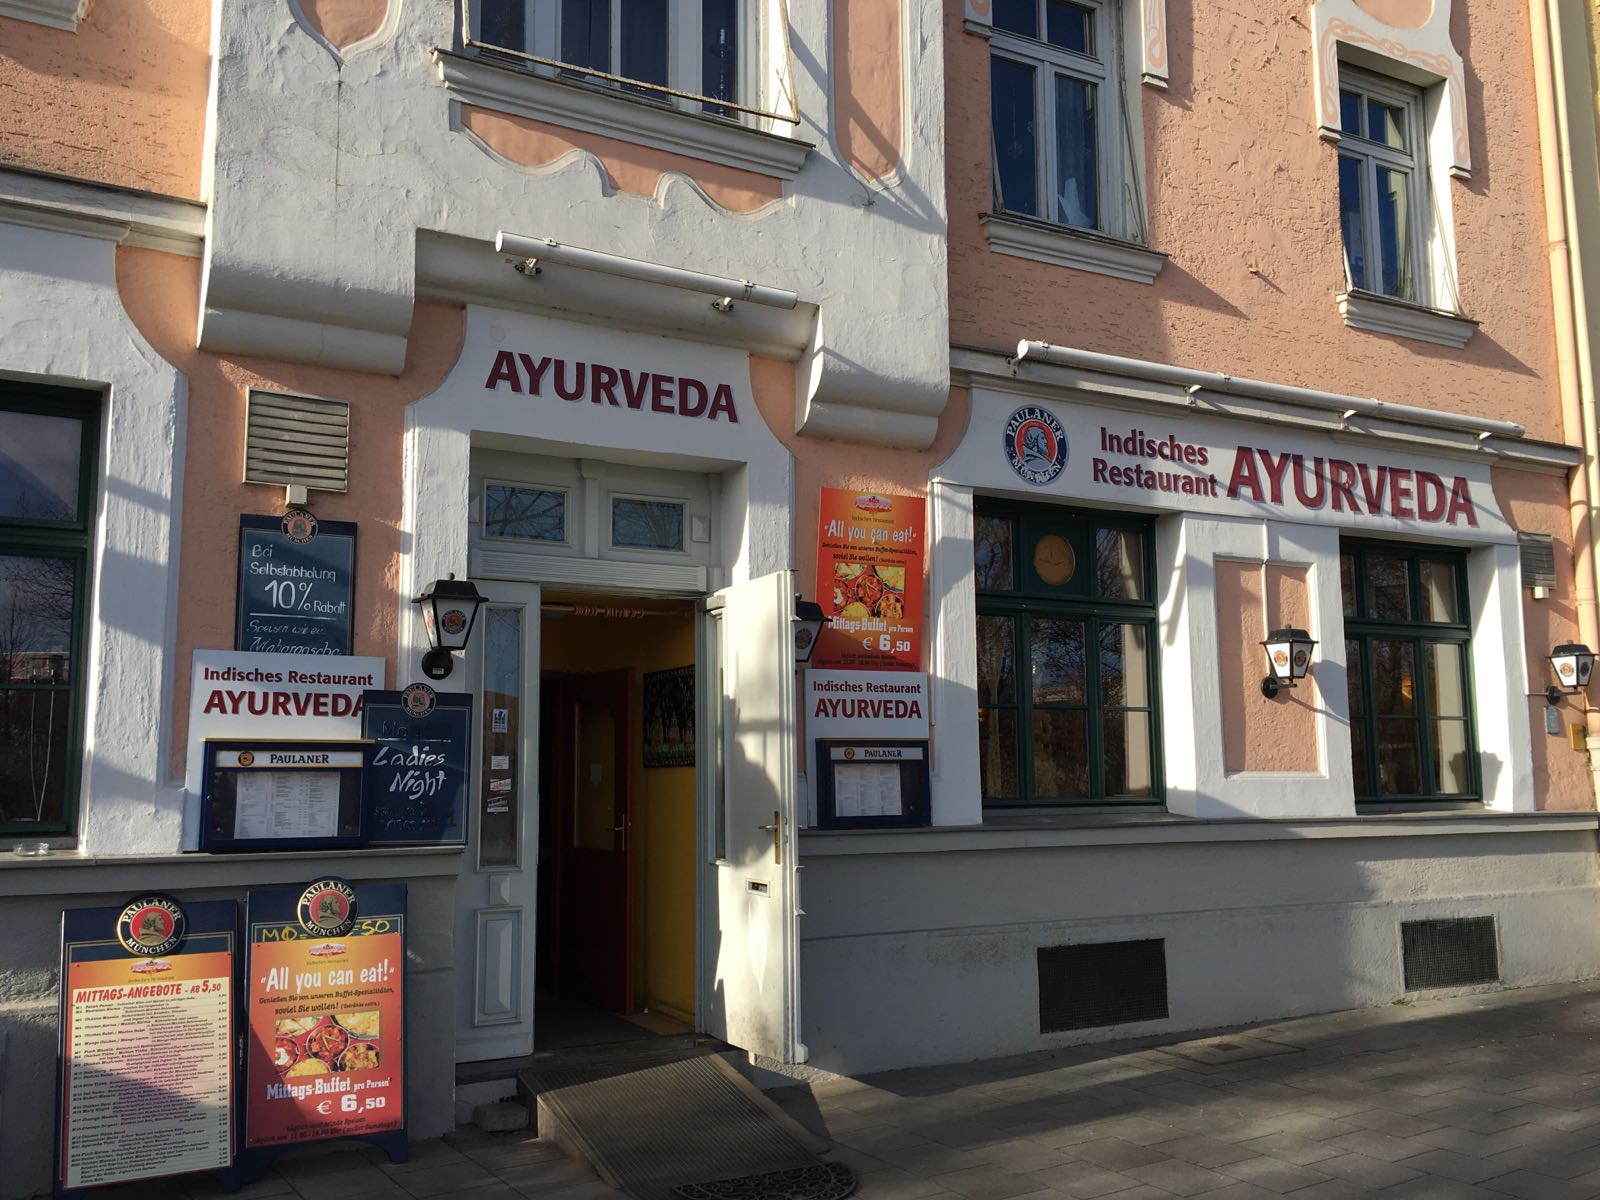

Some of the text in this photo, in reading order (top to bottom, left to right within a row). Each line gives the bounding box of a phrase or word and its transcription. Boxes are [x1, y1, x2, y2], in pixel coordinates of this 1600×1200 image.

[484, 350, 739, 424] AYURVEDA
[1006, 408, 1064, 442] PAULANER
[1100, 427, 1208, 466] Indisches
[1092, 457, 1218, 498] Restaurant
[1227, 445, 1479, 528] AYURVEDA
[848, 526, 866, 543] you
[870, 528, 888, 541] can
[251, 544, 274, 558] Bei
[249, 561, 337, 583] Selbstabholung
[313, 600, 347, 614] Rabatt
[879, 634, 911, 654] 6,50
[203, 667, 374, 687] Indisches Restaurant
[813, 681, 921, 694] Indisches Restaurant
[814, 697, 922, 719] AYURVEDA
[270, 753, 329, 765] PAULANER
[372, 745, 446, 766] Ladies
[864, 749, 903, 758] PAULANER
[389, 770, 447, 800] Night
[301, 880, 356, 906] PAULANER
[121, 898, 183, 924] PAULANER
[305, 918, 352, 937] MÜNCHEN
[125, 935, 178, 955] MÜNCHEN
[75, 984, 182, 1004] MITTAGS-ANGEBOTE
[190, 984, 200, 994] AB
[201, 979, 222, 995] 5,50
[295, 974, 322, 995] you
[328, 969, 353, 986] can
[298, 1004, 310, 1013] Sie
[311, 1001, 339, 1011] wollen!
[266, 1077, 351, 1101] Mittags-Buffet
[316, 1094, 386, 1115] € 6,50
